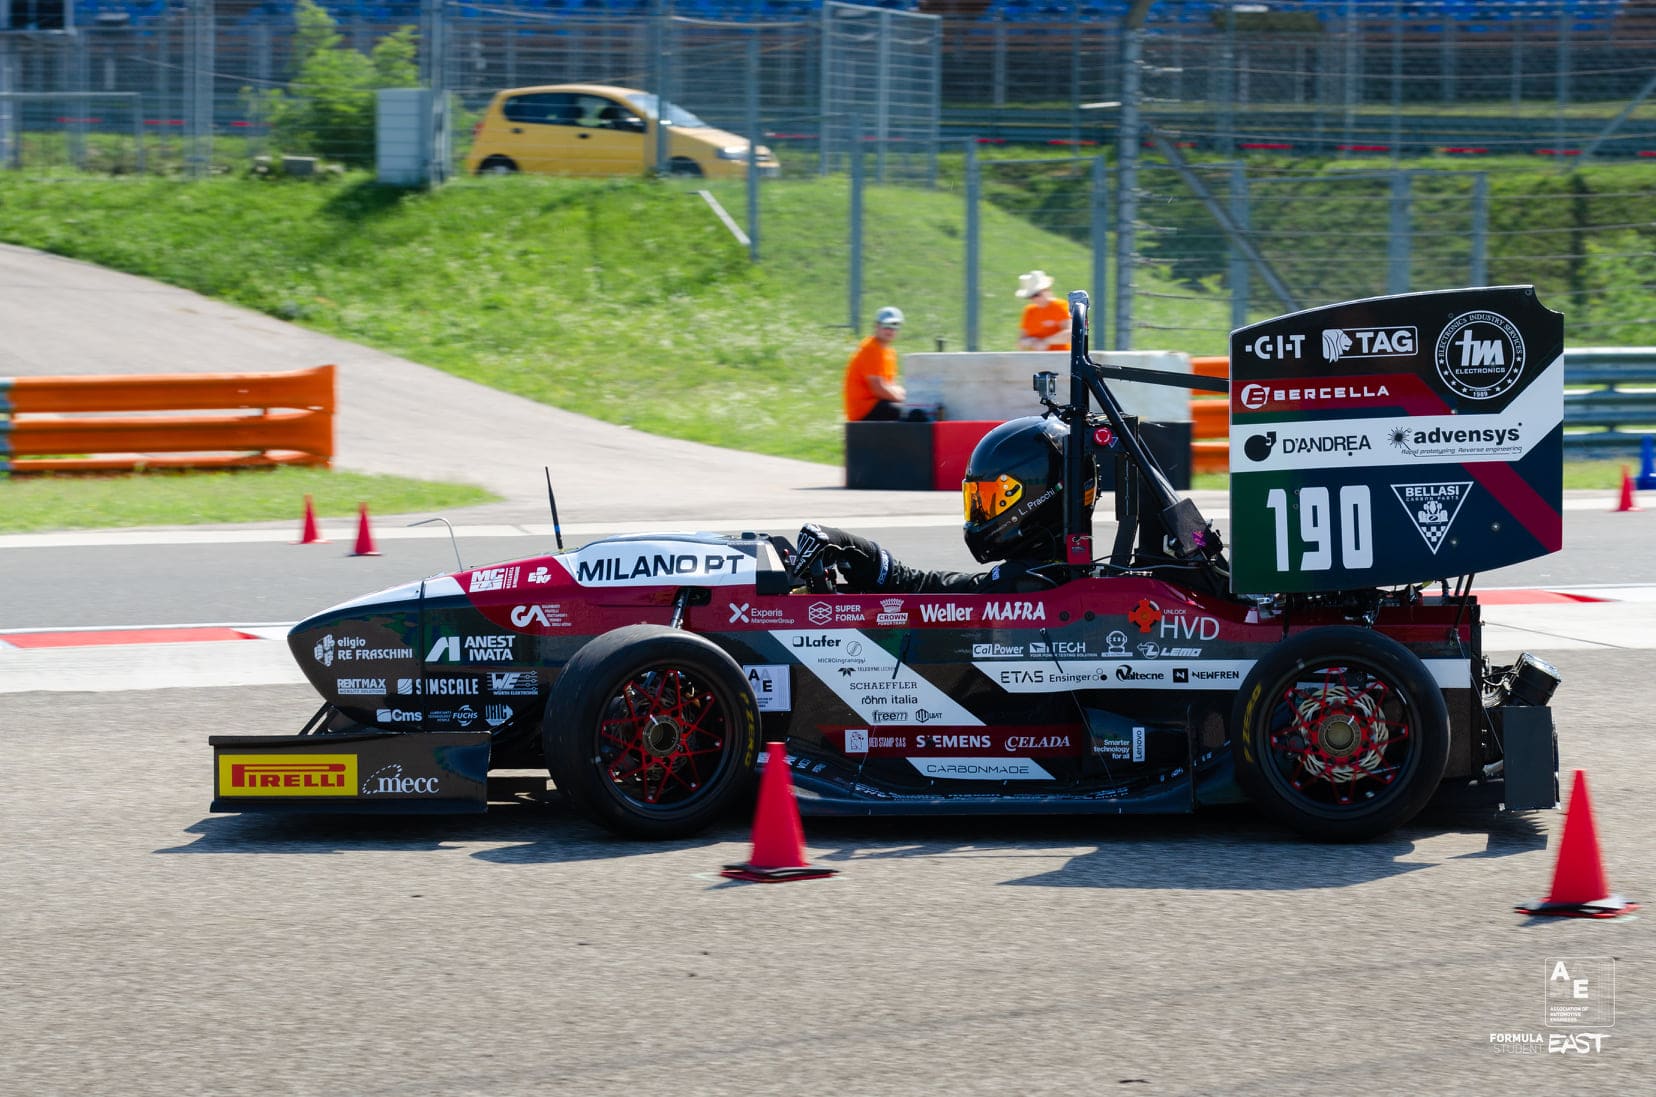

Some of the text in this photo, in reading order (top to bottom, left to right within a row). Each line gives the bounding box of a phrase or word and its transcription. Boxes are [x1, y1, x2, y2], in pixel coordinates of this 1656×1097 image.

[1356, 330, 1413, 354] TAG
[1455, 367, 1506, 375] ELECTRONICS
[1273, 385, 1390, 401] BERCELLA
[1413, 427, 1520, 445] advensys
[1405, 485, 1460, 498] BELLASI
[1027, 488, 1056, 511] Pracchi
[1266, 485, 1373, 572] 190
[578, 555, 697, 582] MILANO
[704, 555, 744, 575] PT
[751, 608, 783, 618] Experis
[835, 604, 861, 613] SUPER
[919, 603, 974, 622] Weller
[982, 601, 1046, 621] MAFRA
[835, 614, 865, 622] FORMA
[1160, 616, 1220, 640] HVD
[337, 636, 366, 649] eligio
[464, 635, 516, 648] ANEST
[806, 635, 842, 648] Lafer
[337, 648, 413, 660] RE FRASCHINI
[469, 648, 513, 661] IWATA
[1049, 673, 1091, 683] Ensinger
[1192, 671, 1240, 680] NEWFREN
[337, 678, 387, 688] RENTMAX
[415, 678, 479, 695] SIMSCALE
[850, 681, 918, 690] SCHAEFFLER
[891, 695, 918, 704] italia
[391, 709, 423, 722] Cms
[916, 735, 992, 748] SEMENS
[1005, 735, 1071, 751] CELADA
[1093, 745, 1130, 753] technology
[232, 764, 346, 787] PIRELLI
[926, 764, 1029, 774] CARBONMADE
